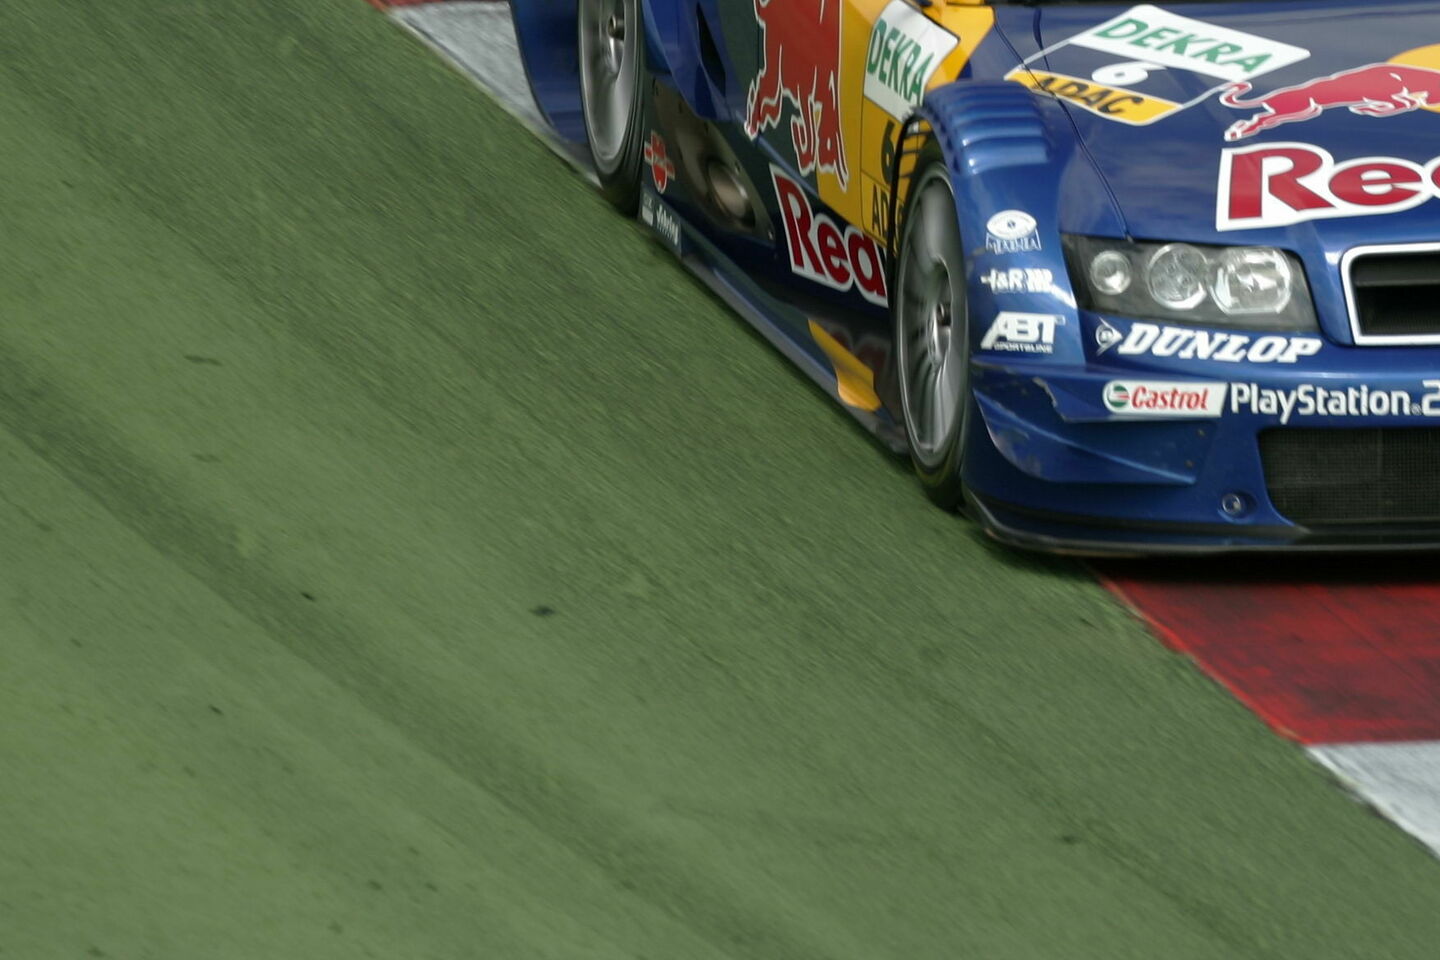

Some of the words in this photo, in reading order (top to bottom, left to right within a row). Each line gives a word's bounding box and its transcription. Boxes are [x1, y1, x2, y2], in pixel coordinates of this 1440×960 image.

[866, 17, 935, 107] DEKRA
[1093, 17, 1273, 73] DEKRA
[1091, 60, 1167, 86] 6
[1033, 76, 1144, 116] ADAC
[980, 310, 1058, 350] ABT
[1116, 321, 1323, 363] DUNLOP
[1130, 385, 1210, 412] Castrol
